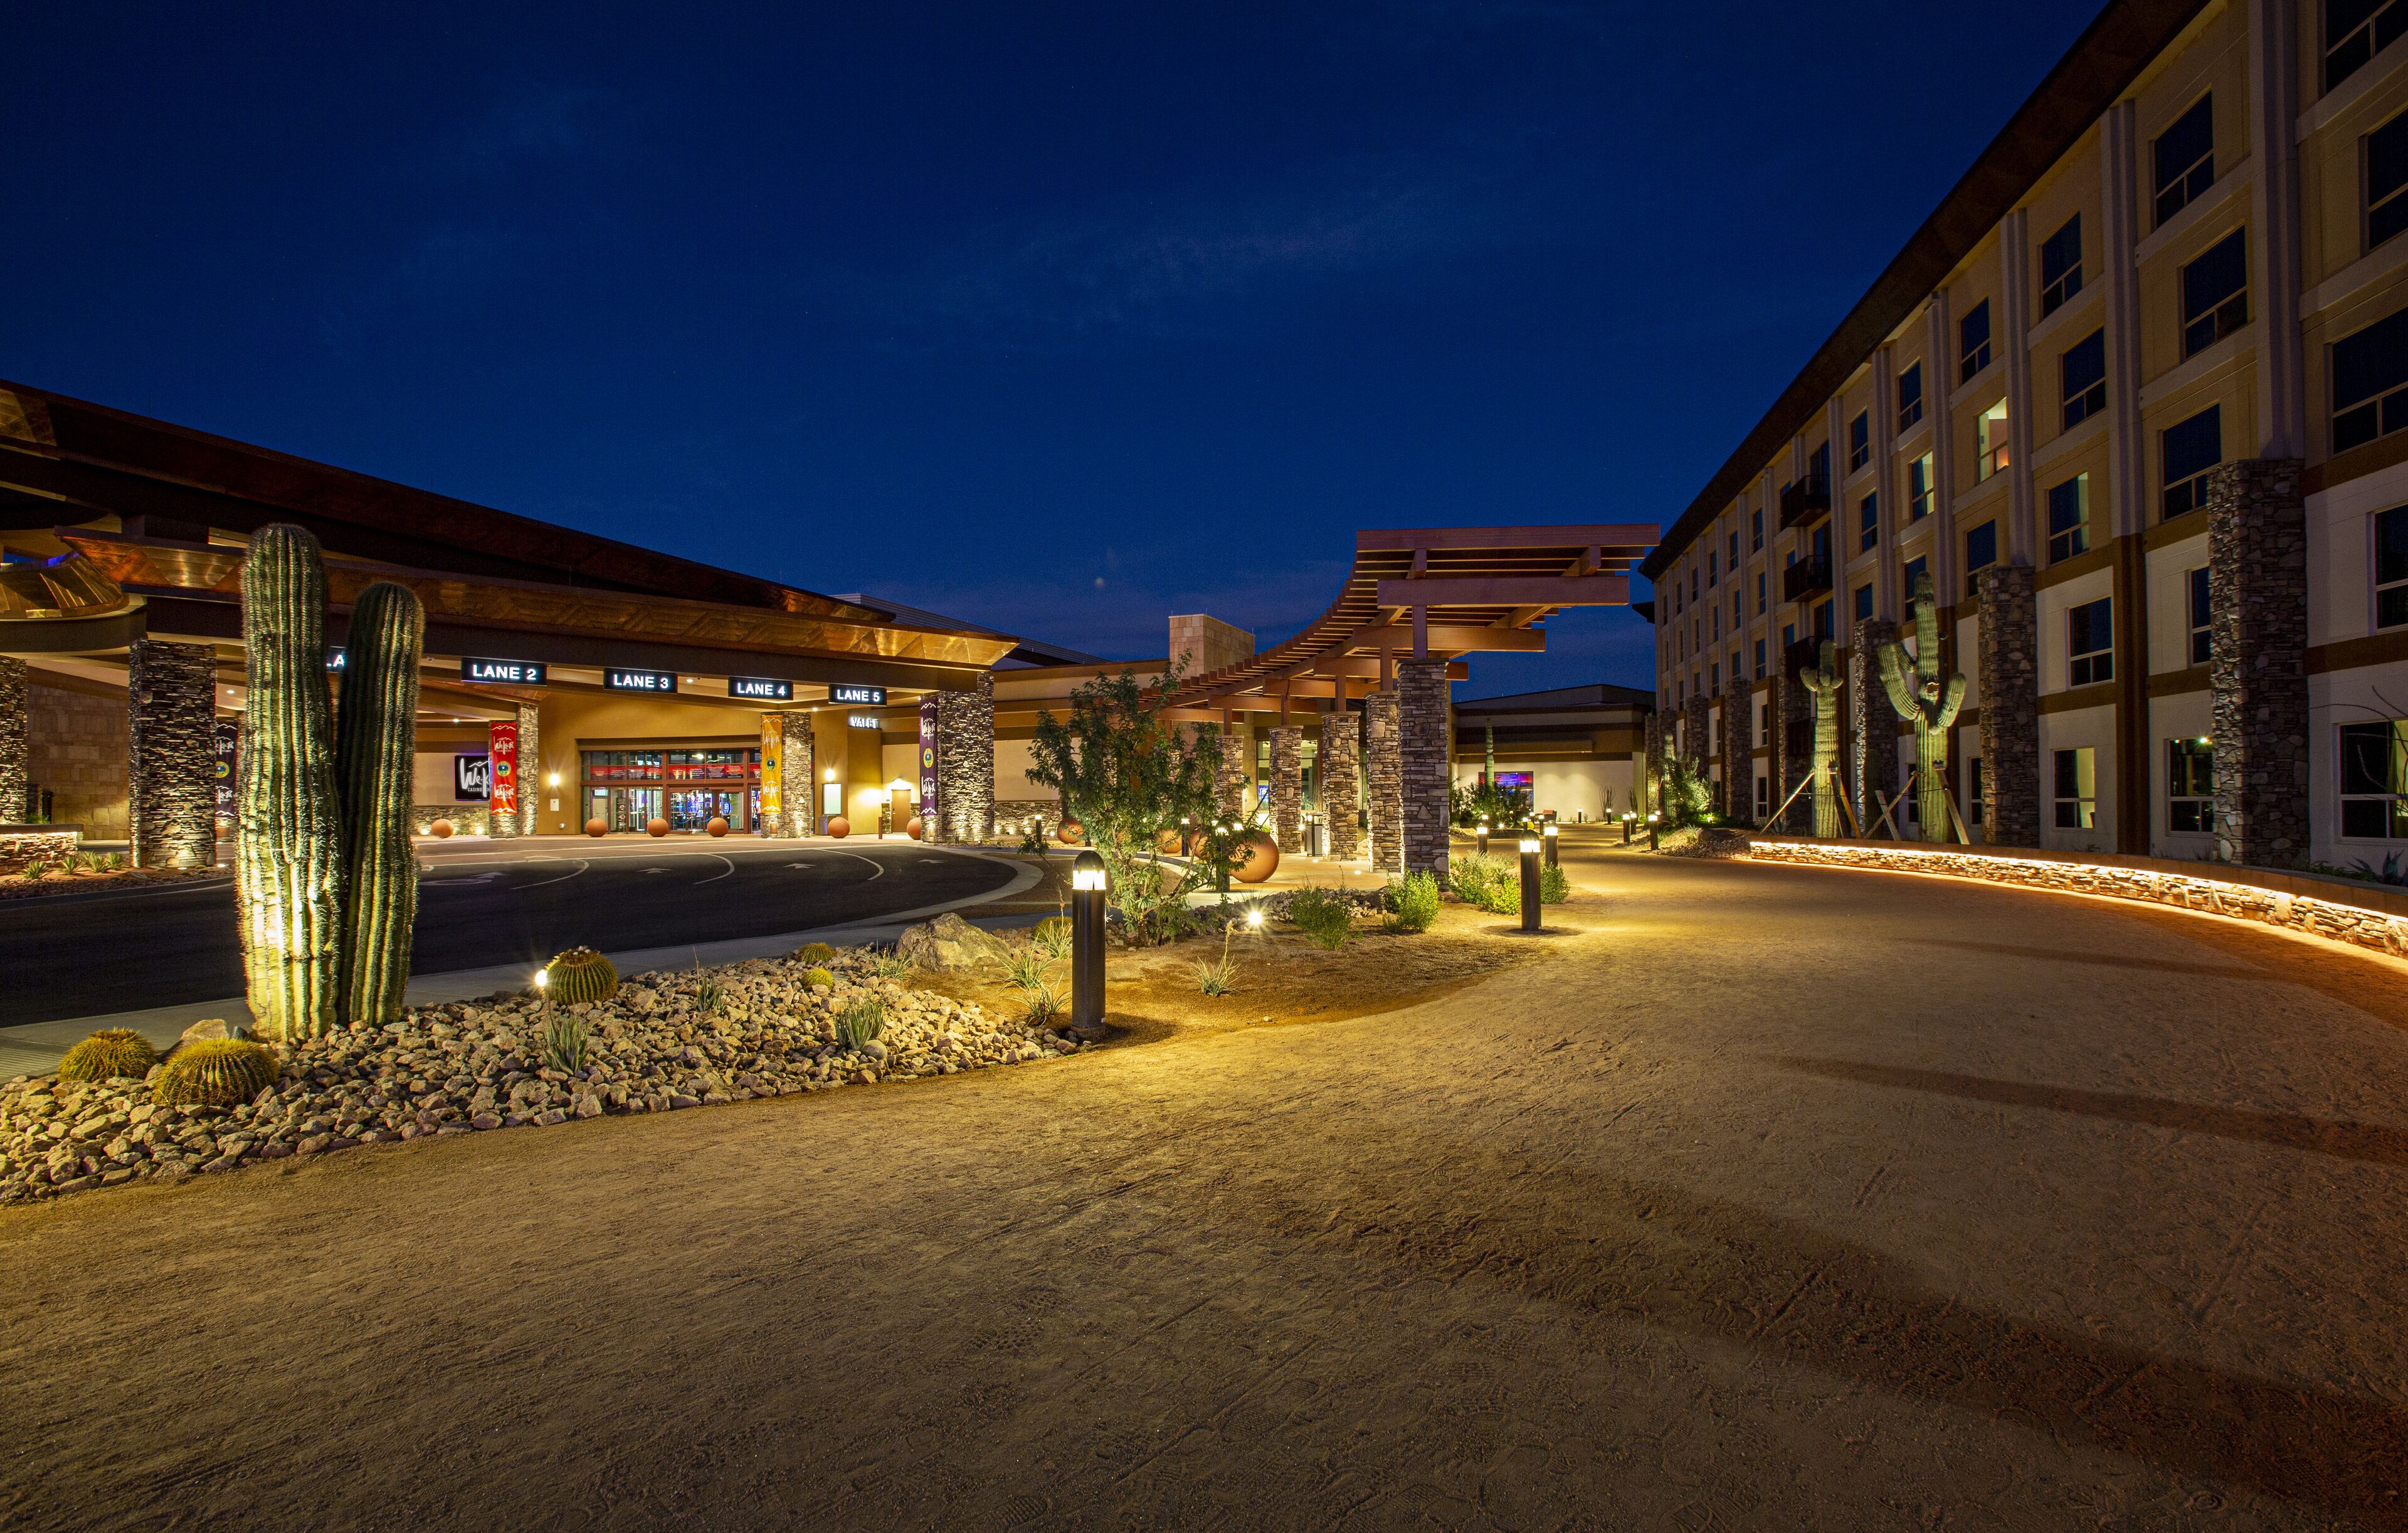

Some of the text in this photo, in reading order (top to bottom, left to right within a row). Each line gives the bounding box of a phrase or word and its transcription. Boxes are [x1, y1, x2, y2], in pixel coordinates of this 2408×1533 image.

[473, 664, 537, 680] LANE 2
[614, 674, 668, 688] LANE 3
[737, 682, 785, 696] LANE 4
[837, 689, 880, 702] LANE 5
[852, 717, 879, 729] VALET
